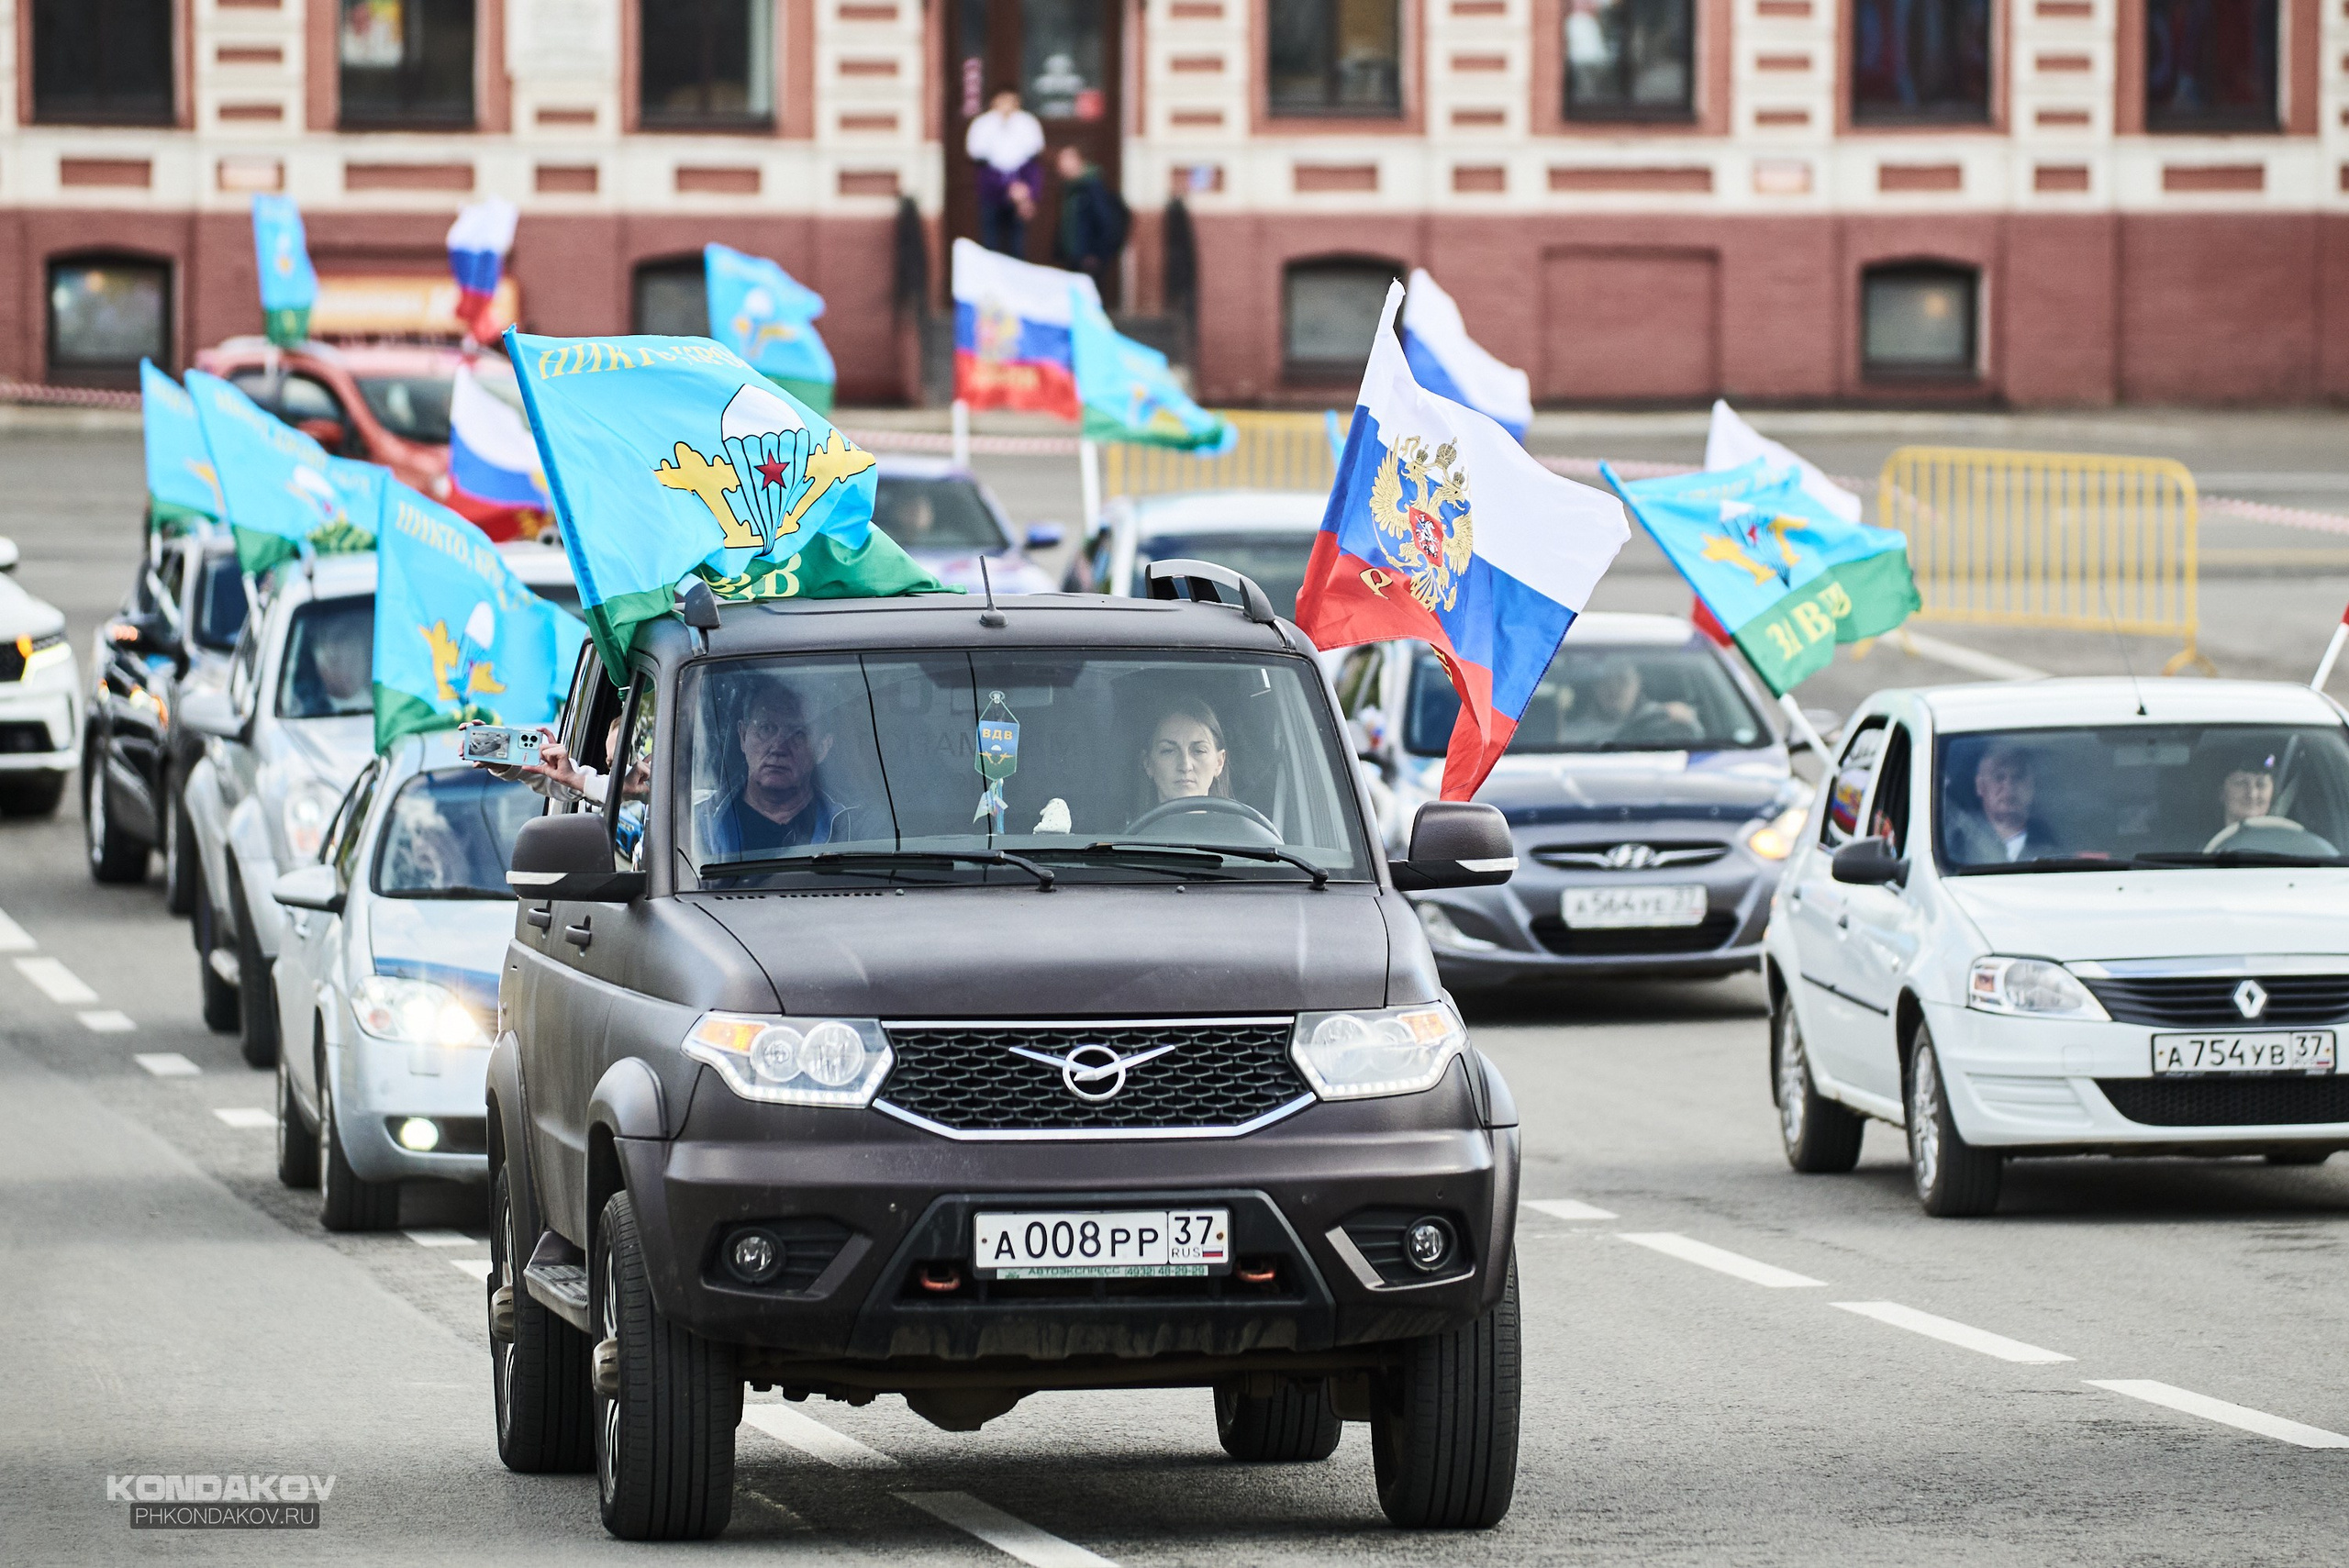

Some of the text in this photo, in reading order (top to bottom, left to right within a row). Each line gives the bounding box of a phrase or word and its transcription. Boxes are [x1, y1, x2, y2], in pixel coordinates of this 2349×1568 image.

[982, 728, 1013, 741] ВДВ
[2168, 1035, 2323, 1068] А754УВ 37
[994, 1216, 1214, 1261] А008РР 37
[1171, 1247, 1201, 1259] RUS
[1027, 1265, 1121, 1277] АВТОЭКСПРЕСС
